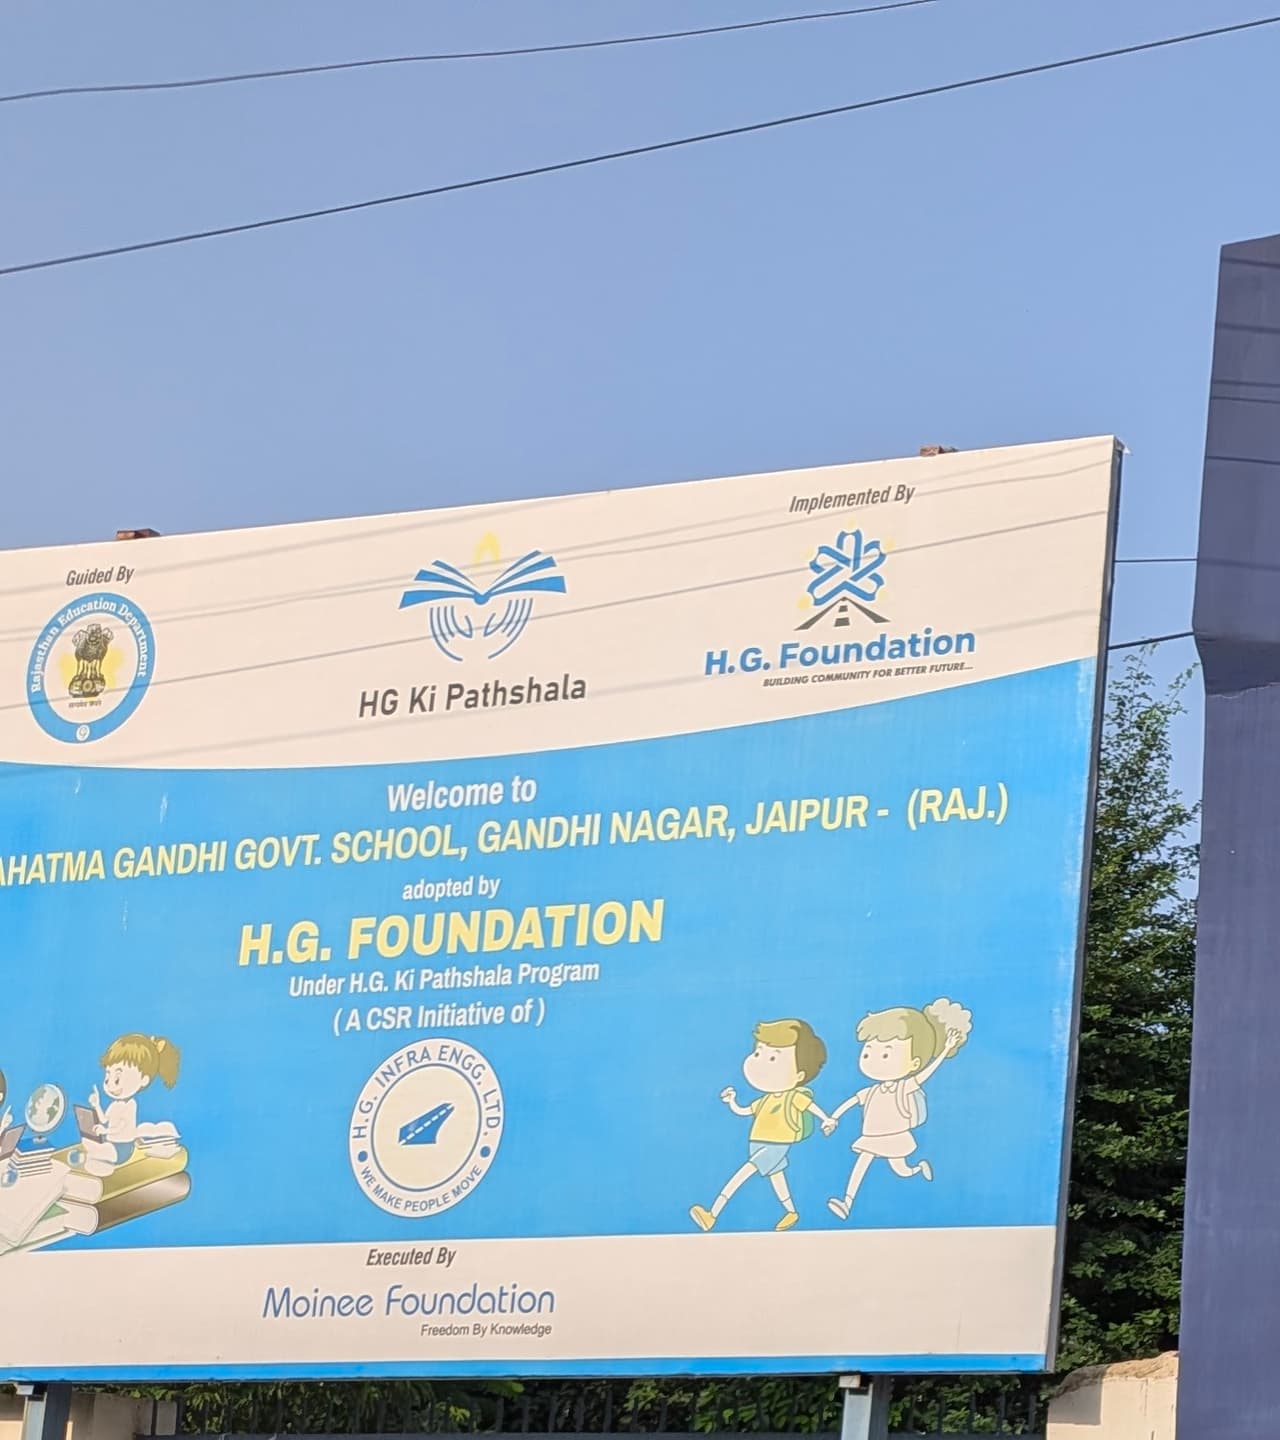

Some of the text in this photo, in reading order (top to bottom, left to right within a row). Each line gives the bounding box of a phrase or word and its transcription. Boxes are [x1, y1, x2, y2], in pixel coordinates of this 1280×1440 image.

[789, 484, 914, 515] Implemented By
[66, 566, 134, 586] Guided By
[31, 597, 149, 694] Rajasthan Education Department
[705, 631, 976, 677] H.G. Foundation
[763, 666, 927, 687] BUILDING COMMUNITY FOR BETTER
[359, 674, 586, 718] HG Ki Pathshala
[388, 776, 537, 812] Welcome to
[114, 783, 1009, 879] GANDHI GOVT. SCHOOL, GANDHI NAGAR, JAIPUR (RAJ.)
[403, 876, 501, 901] adopted by
[239, 899, 665, 966] H.G. FOUNDATION
[289, 962, 600, 997] Under H.G. Ki Pathshala Program
[366, 999, 533, 1031] CSR Initiative of
[375, 1045, 486, 1088] INFRA ENGG.
[361, 1165, 482, 1212] WE MAKE PEOPLE MOVE
[366, 1247, 457, 1268] Executed By
[262, 1283, 555, 1318] Moinee Foundation
[420, 1323, 552, 1338] Freedom By Knowledge
